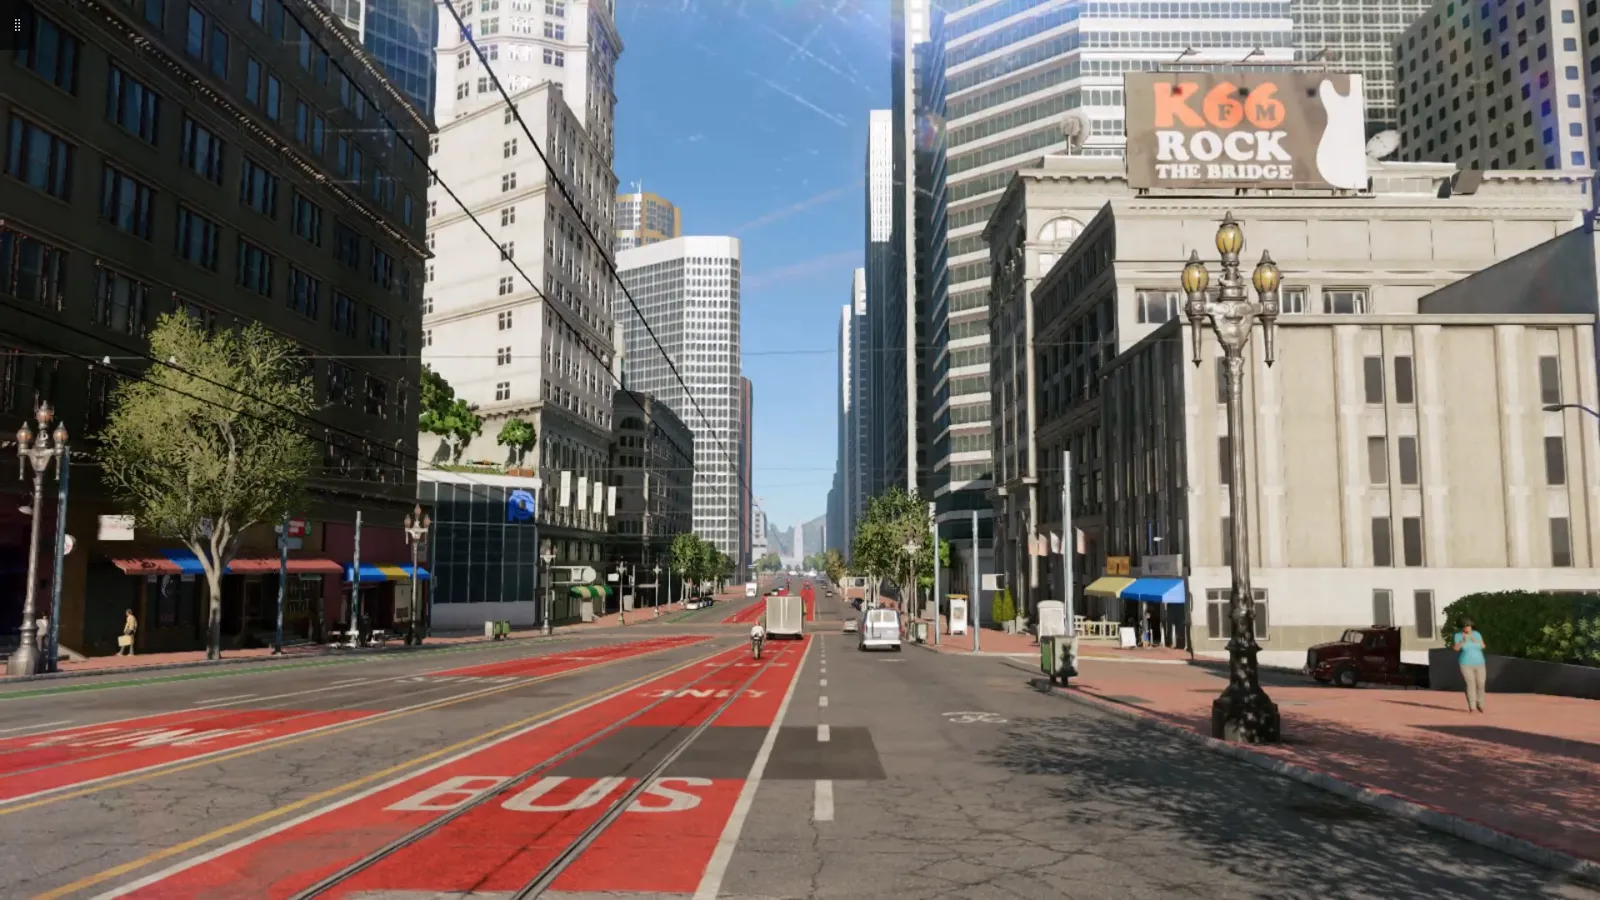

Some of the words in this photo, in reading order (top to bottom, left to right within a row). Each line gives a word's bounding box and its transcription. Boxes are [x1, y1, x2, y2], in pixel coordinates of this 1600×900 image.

[1153, 81, 1286, 129] K66
[1155, 130, 1293, 162] ROCK
[1155, 164, 1200, 180] THE
[1207, 164, 1293, 179] BRIDGE
[381, 775, 714, 813] BUS
